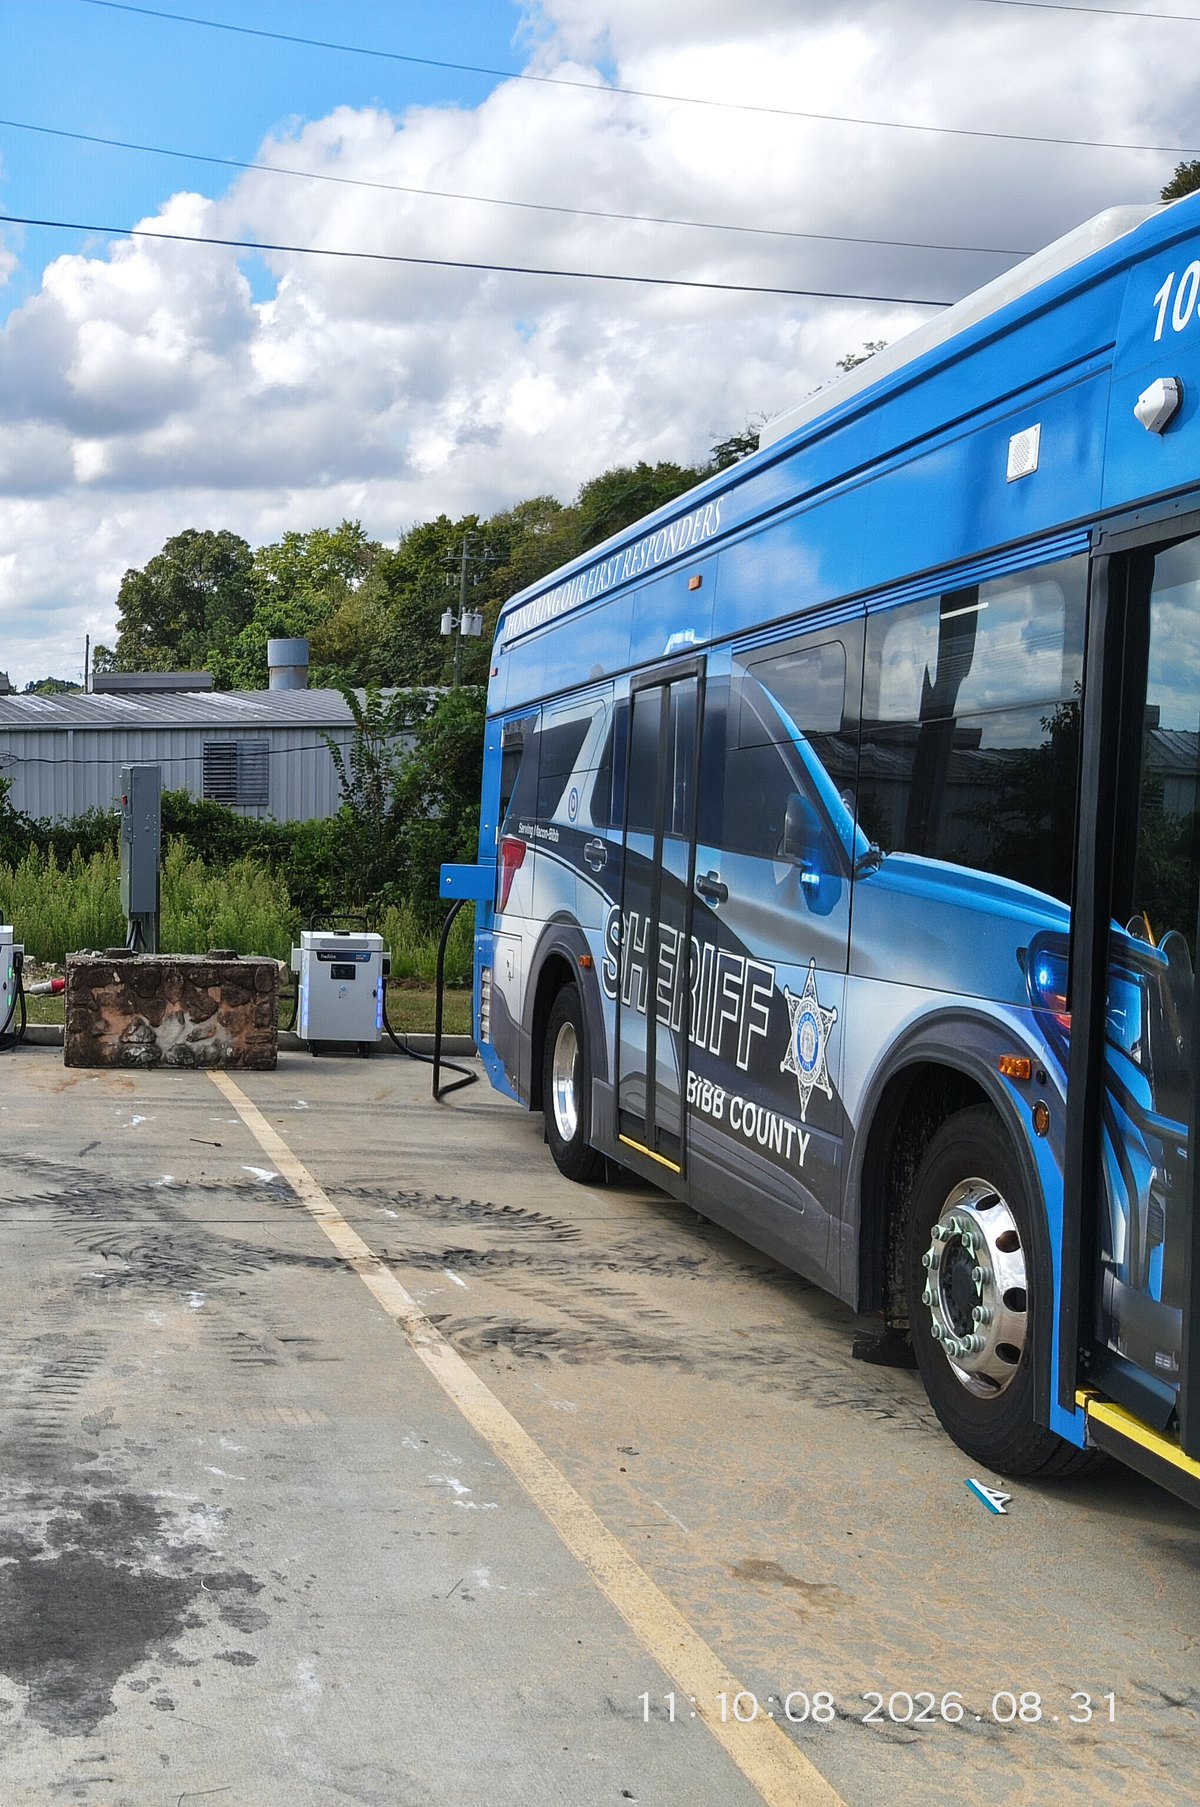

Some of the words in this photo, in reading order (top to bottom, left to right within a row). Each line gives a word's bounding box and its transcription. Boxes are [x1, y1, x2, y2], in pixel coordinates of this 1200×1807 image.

[1153, 259, 1200, 342] 10
[506, 588, 561, 638] HONORING
[561, 574, 586, 611] OUR
[586, 552, 622, 600] FIRST
[621, 496, 724, 580] RESPONDERS
[518, 822, 534, 838] Serving
[602, 905, 775, 1072] SHERIFF
[686, 1070, 726, 1120] BIBB
[729, 1096, 811, 1168] COUNTY
